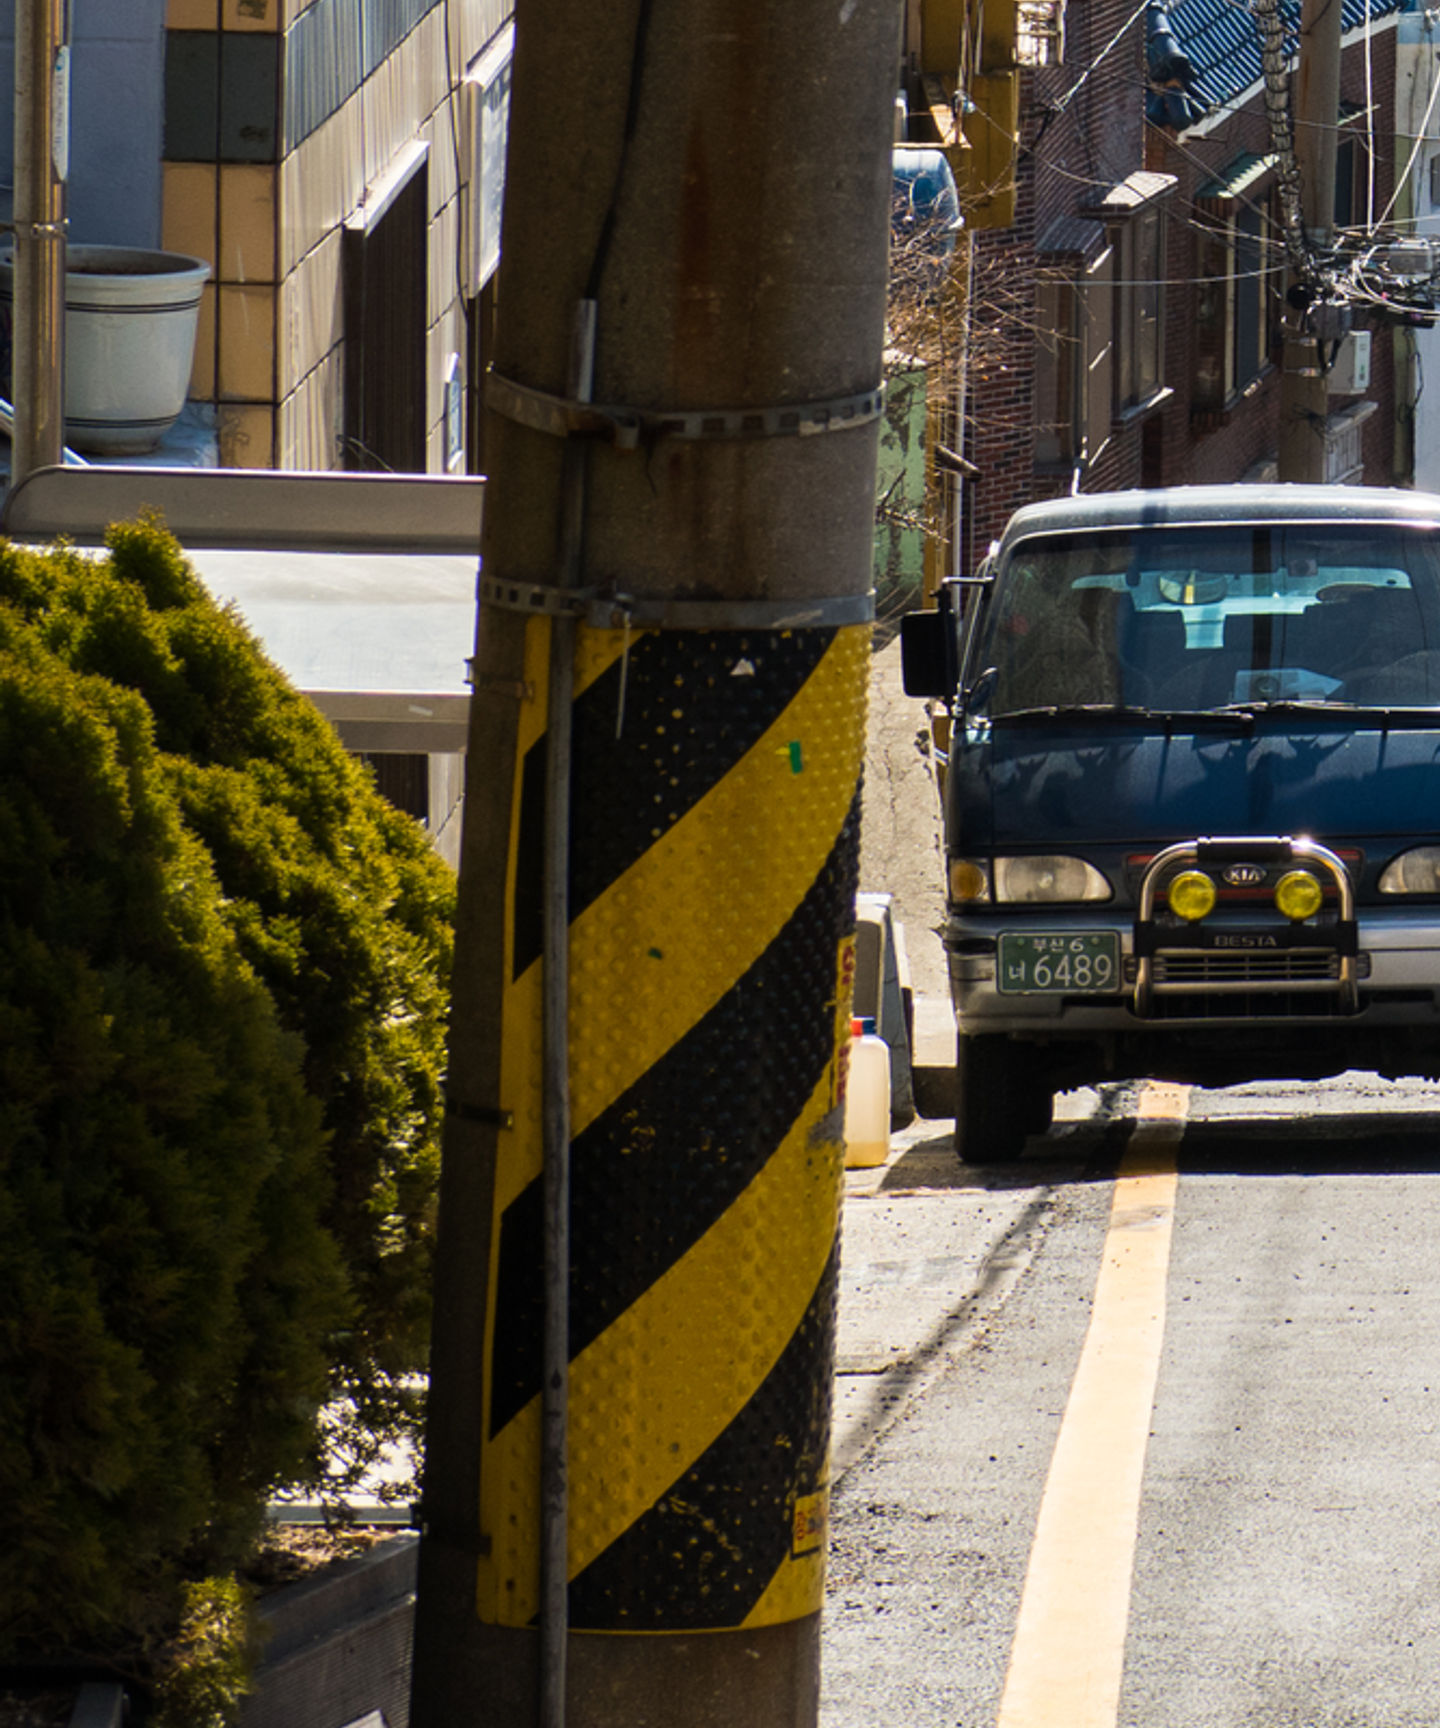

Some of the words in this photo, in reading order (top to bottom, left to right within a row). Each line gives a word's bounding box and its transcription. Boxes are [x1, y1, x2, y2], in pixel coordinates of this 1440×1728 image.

[1229, 868, 1261, 881] KIA
[1033, 937, 1064, 952] 부산
[1069, 936, 1084, 953] 6
[1213, 935, 1278, 947] BESTA
[1033, 954, 1112, 988] 6489
